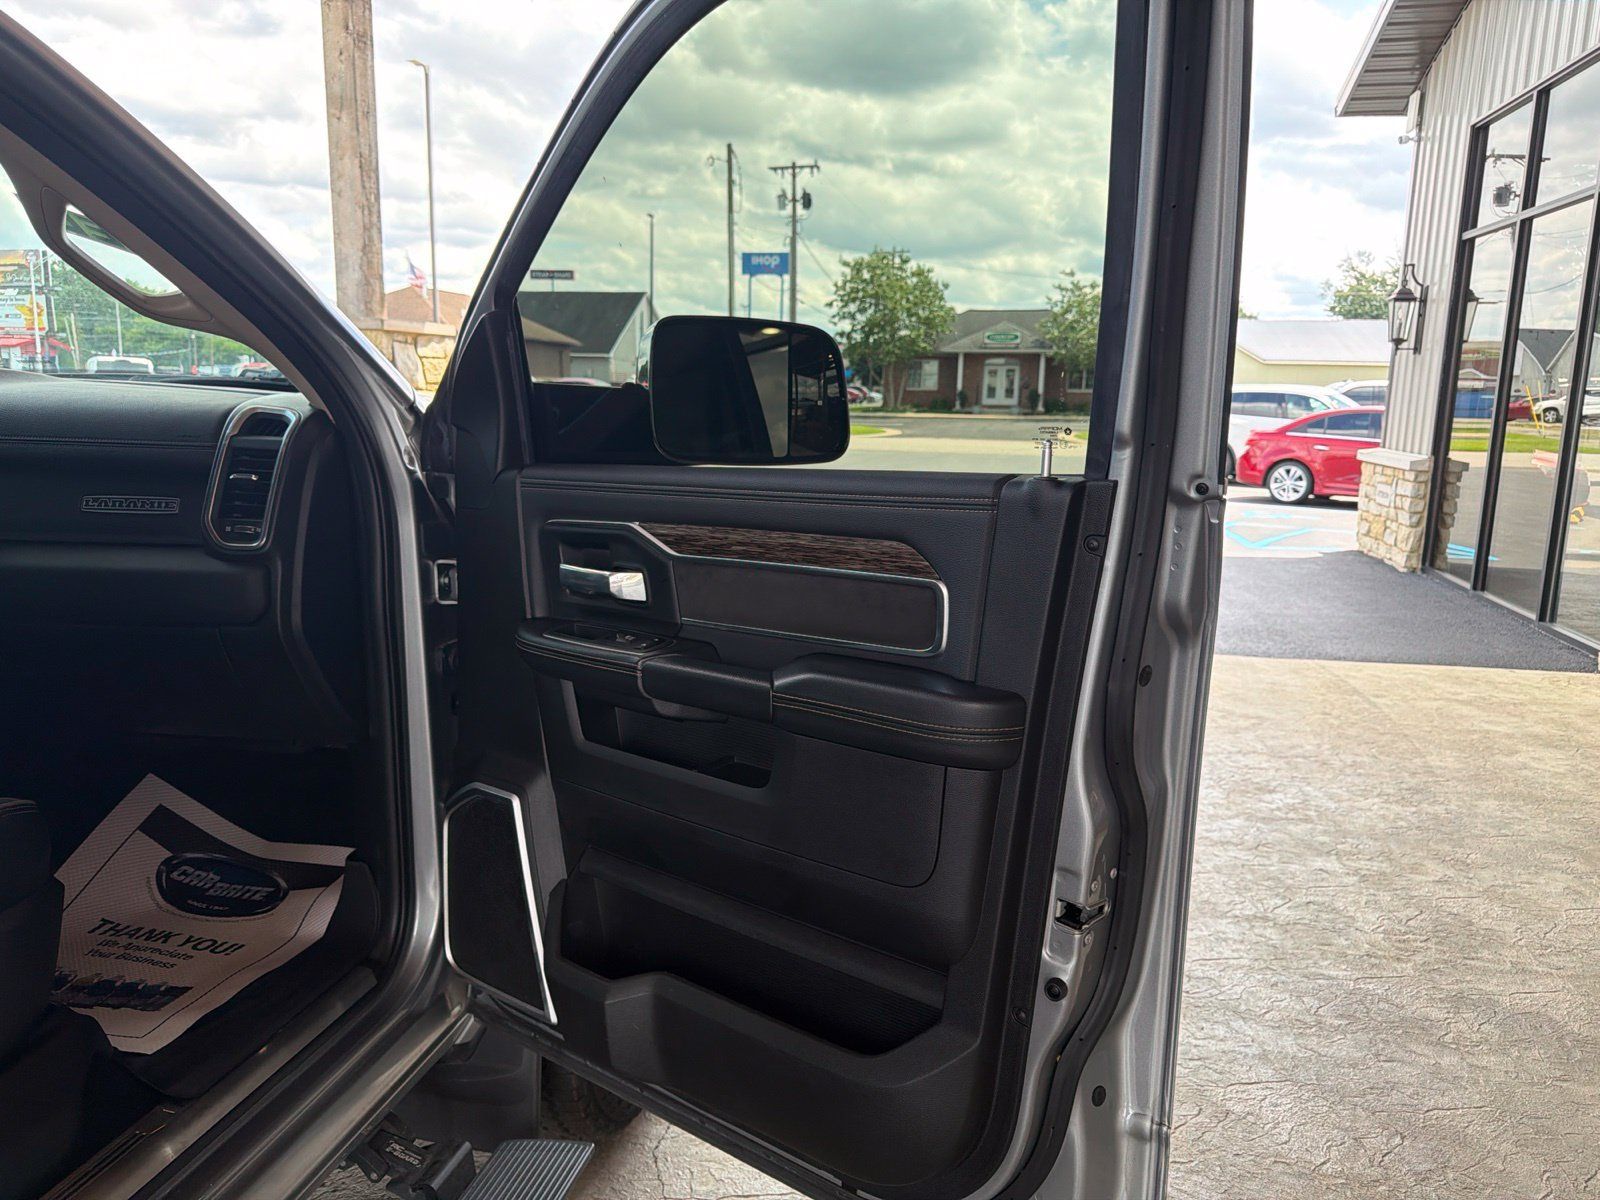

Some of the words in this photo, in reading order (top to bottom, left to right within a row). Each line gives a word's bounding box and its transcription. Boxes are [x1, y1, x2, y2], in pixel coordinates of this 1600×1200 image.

[83, 498, 177, 510] LARAMIE
[87, 917, 181, 944] THANK
[177, 934, 245, 956] YOU!
[84, 948, 115, 960] Your
[115, 951, 178, 969] Business
[119, 941, 194, 961] Appreciate
